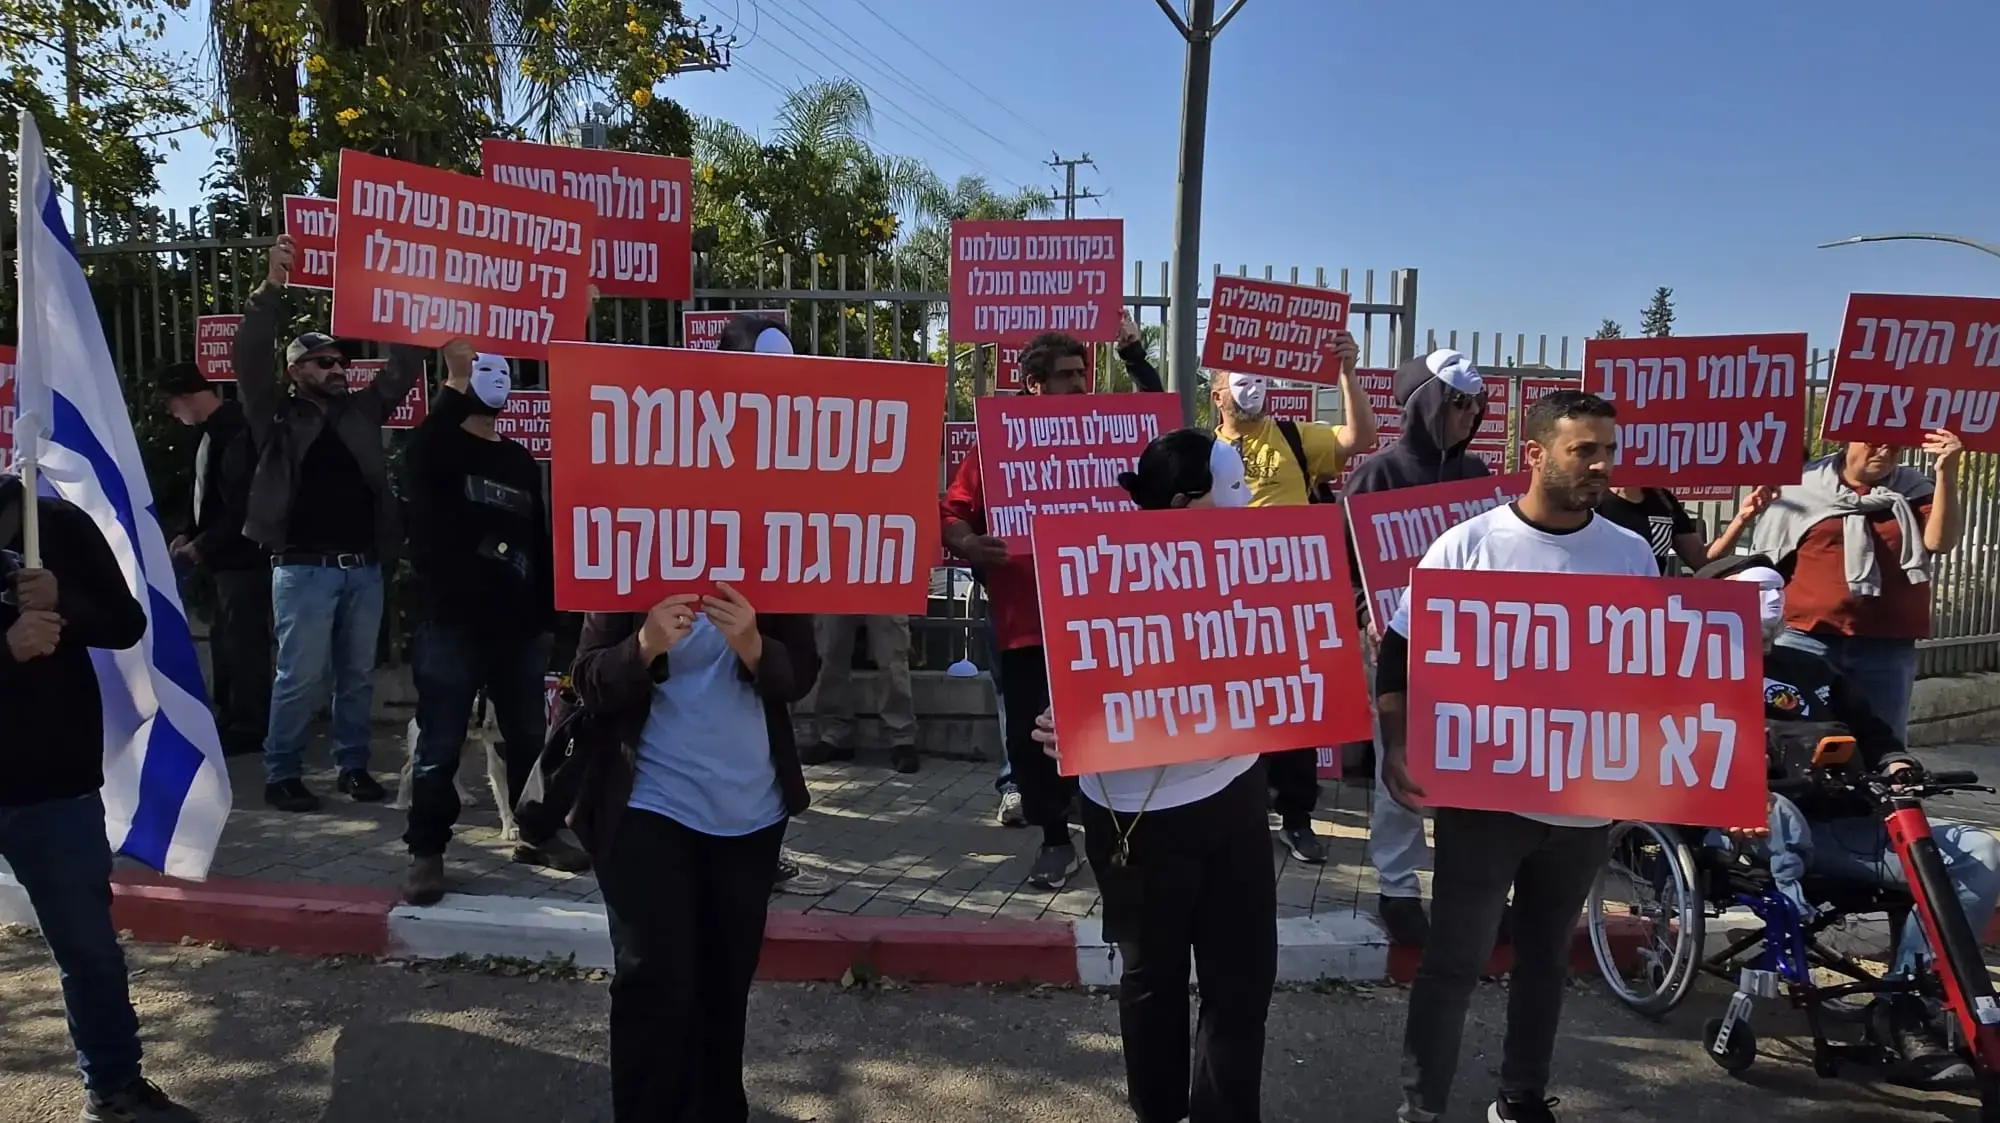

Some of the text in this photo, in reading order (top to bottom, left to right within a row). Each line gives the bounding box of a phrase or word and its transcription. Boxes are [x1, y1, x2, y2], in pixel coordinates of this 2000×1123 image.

[352, 179, 450, 231] נשלחנו
[562, 166, 644, 219] מלחמה
[651, 179, 681, 222] נכי
[296, 207, 336, 238] לומי
[457, 200, 582, 255] בפקודתכם
[364, 229, 566, 299] כדי שאתם תוכלו
[613, 240, 657, 283] נפש
[959, 232, 1115, 264] בפקודתכם נשלחנו
[968, 266, 1106, 296] כדי שאתם תוכלו
[1219, 285, 1342, 322] תופסק האפליה
[372, 287, 555, 345] לחיות והופקרנו
[691, 320, 705, 335] את
[974, 300, 1099, 335] לחיות והופקרנו
[1215, 313, 1261, 339] הקרב
[1265, 320, 1312, 345] הלומי
[200, 342, 228, 357] הקרב
[208, 360, 233, 373] יזיים
[1222, 342, 1323, 374] לנכים פיזיים
[1849, 317, 2000, 370] מי הקרב
[1595, 345, 1795, 409] הלומי הקרב
[1272, 396, 1308, 411] תופסק
[1829, 382, 2000, 433] שים צדק
[532, 438, 552, 451] כים
[590, 385, 909, 473] פוסטראומה
[951, 429, 976, 446] פליה
[1002, 409, 1159, 451] מי ששילם בנפשו על
[1738, 412, 1787, 465] לא
[999, 459, 1038, 498] צריך
[1040, 454, 1062, 490] לא
[573, 506, 916, 595] הורגת בשקט
[1058, 535, 1331, 597] תופסק האפליה
[1066, 615, 1175, 676] הקרב
[1182, 599, 1286, 660] הלומי
[1292, 602, 1343, 660] בין
[1424, 598, 1570, 681] הקרב
[1588, 595, 1745, 680] הלומי
[1102, 664, 1324, 743] לנכים פיזיים
[1434, 702, 1737, 792] לא שקופים
